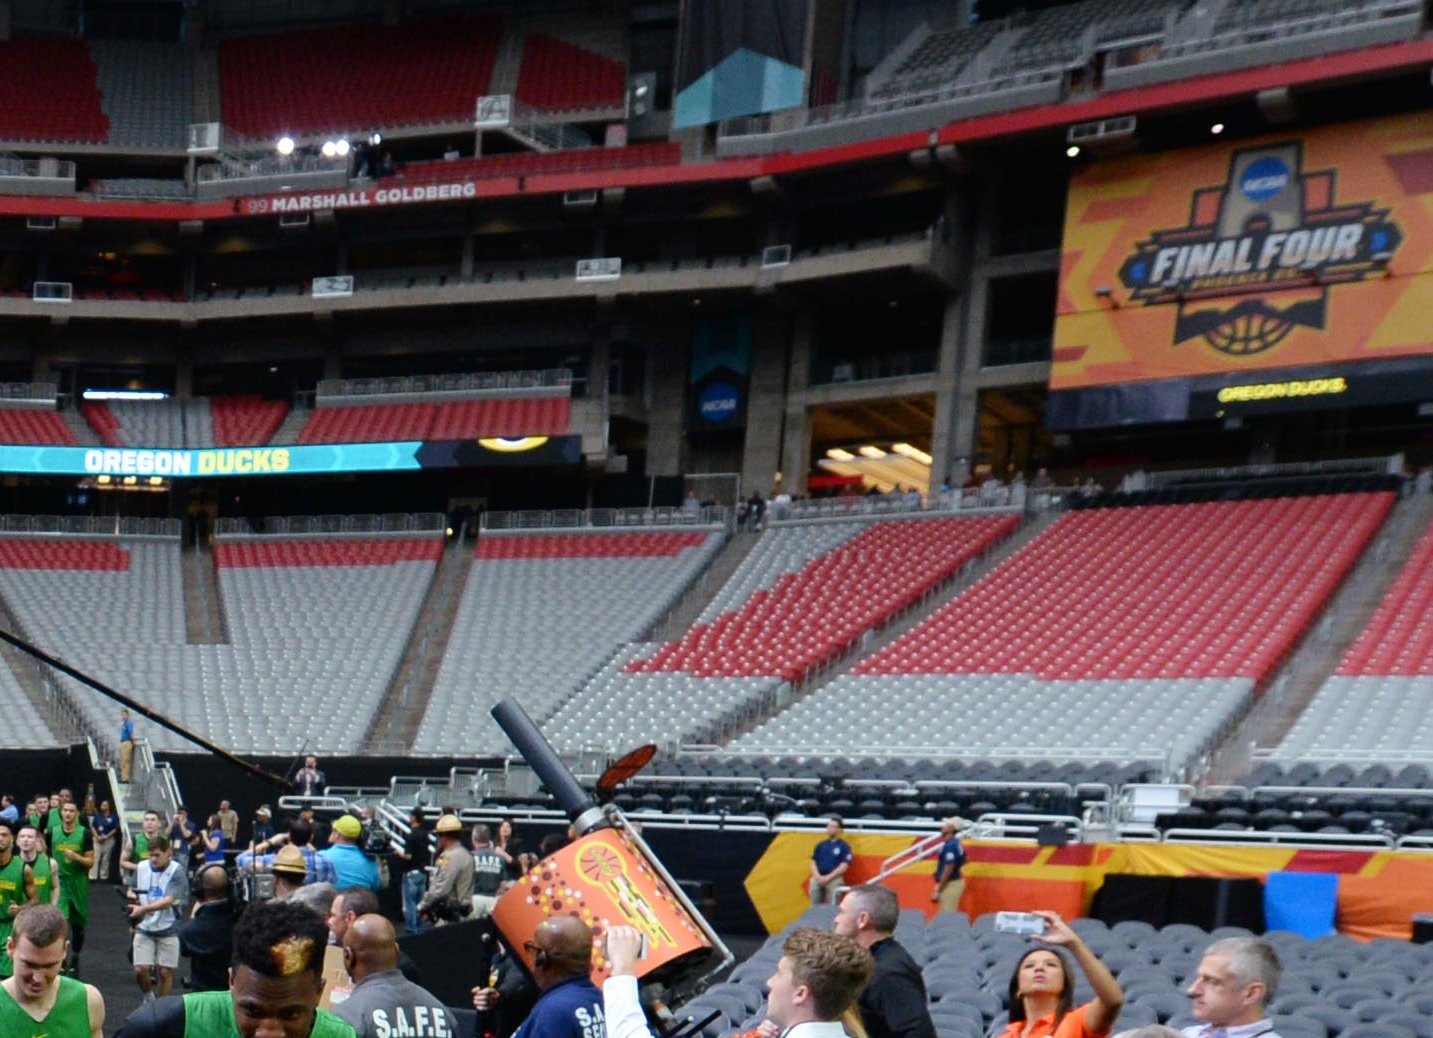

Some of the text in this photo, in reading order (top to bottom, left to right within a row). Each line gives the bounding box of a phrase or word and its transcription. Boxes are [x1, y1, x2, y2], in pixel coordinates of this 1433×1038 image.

[248, 183, 477, 213] 99 MARSHALL GOLDBERG
[1150, 223, 1365, 286] FINAL FOUR
[1218, 383, 1288, 402] OREGON
[85, 448, 290, 475] OREGON DUCKS
